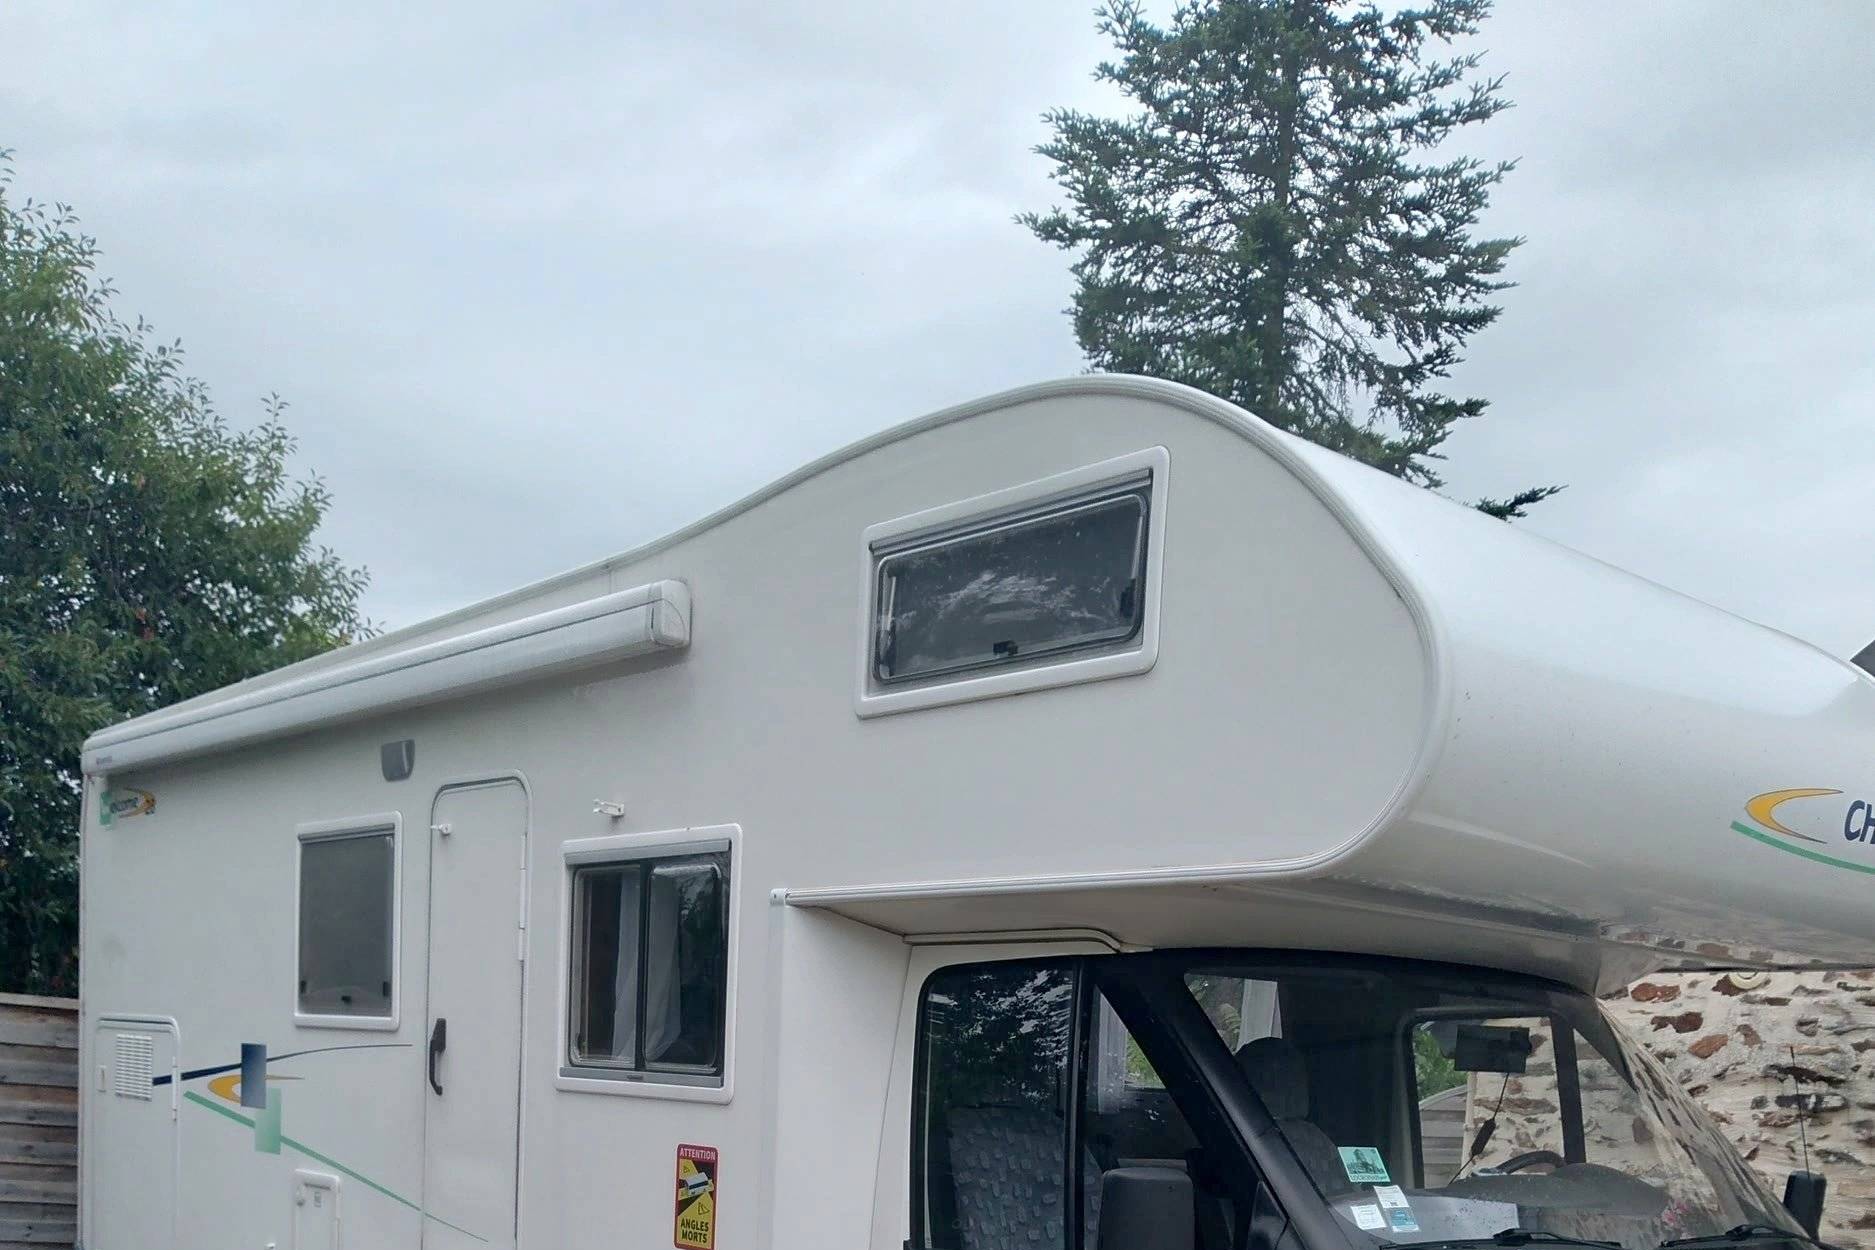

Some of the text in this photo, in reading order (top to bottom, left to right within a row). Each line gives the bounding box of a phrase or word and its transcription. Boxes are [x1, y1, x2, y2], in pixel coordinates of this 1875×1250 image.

[679, 1148, 716, 1161] ATTENTION
[680, 1218, 709, 1232] ANGLES
[681, 1230, 707, 1243] MORTS
